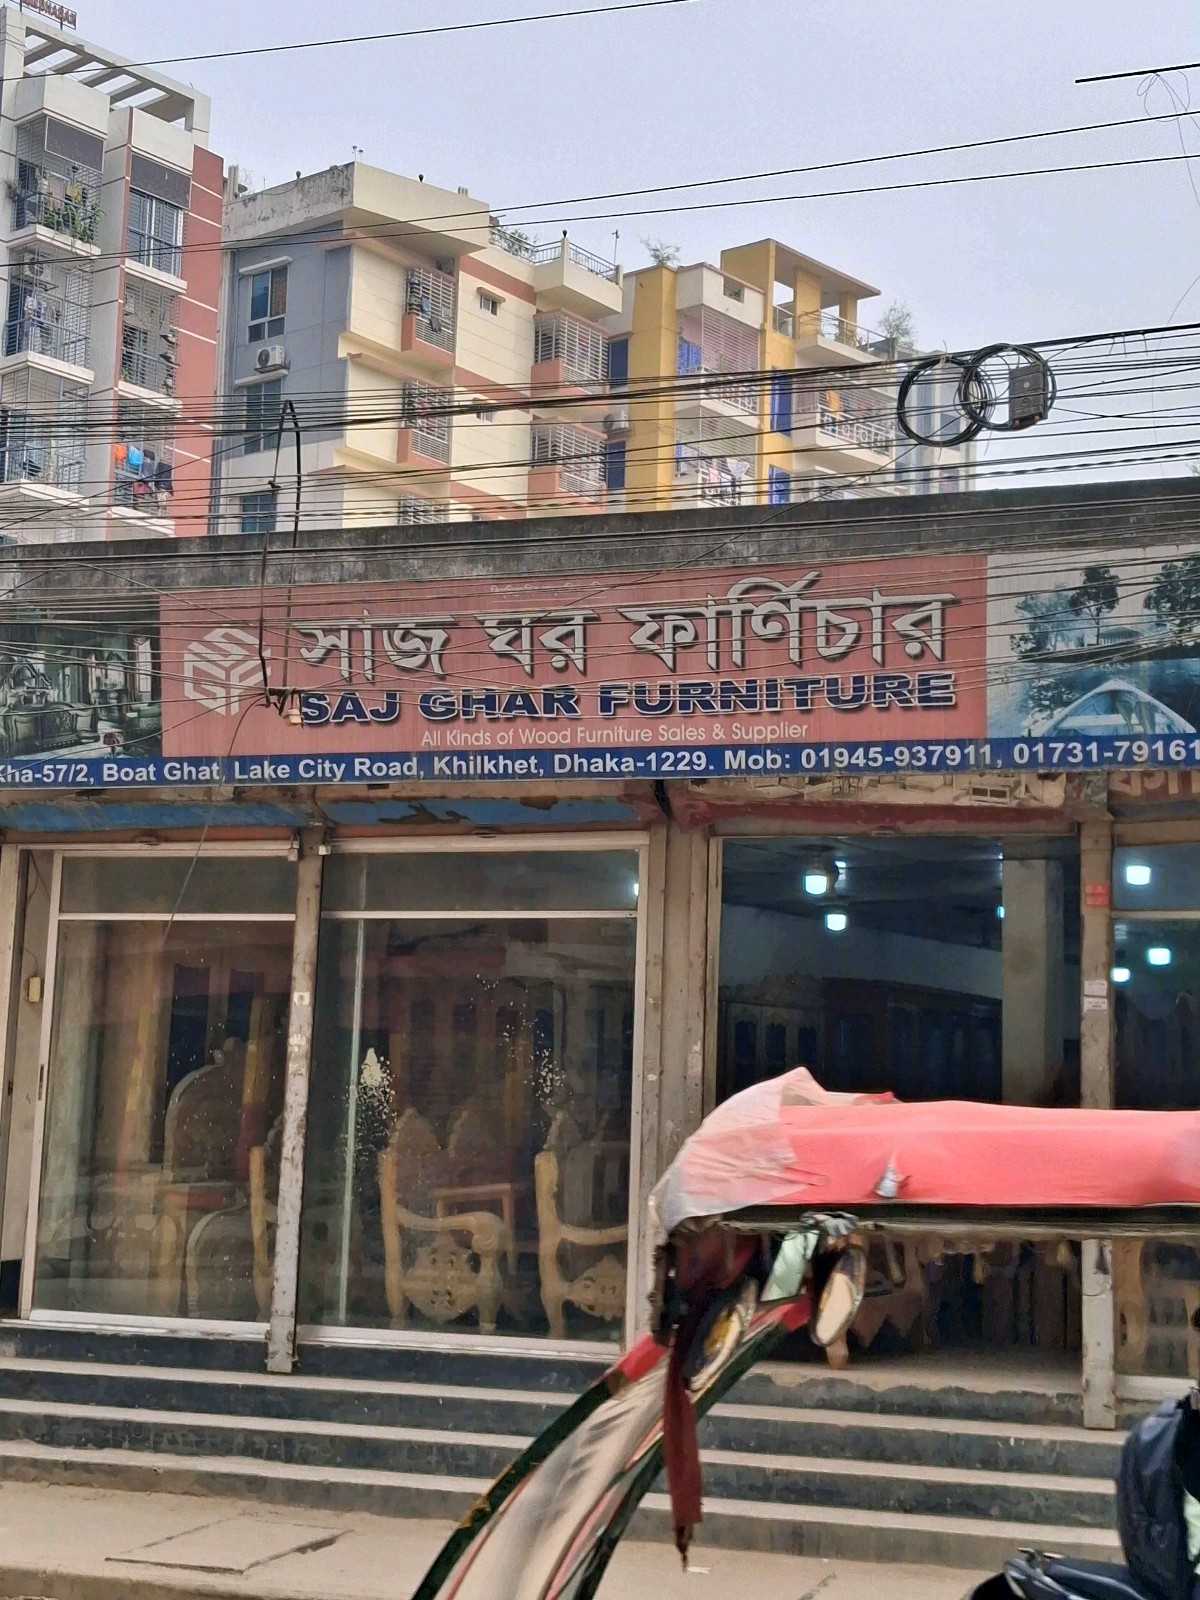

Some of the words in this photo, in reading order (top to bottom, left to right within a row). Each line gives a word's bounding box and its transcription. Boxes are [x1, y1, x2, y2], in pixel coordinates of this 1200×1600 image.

[291, 608, 458, 682] সাজ
[474, 610, 599, 677] ঘর
[301, 690, 400, 725] SAJ
[417, 684, 583, 721] GHAR
[598, 672, 956, 716] FURNITURE
[421, 729, 442, 747] All
[446, 728, 492, 746] Kinds
[497, 728, 514, 745] of
[517, 725, 571, 745] Wood
[577, 725, 653, 743] Furniture
[658, 723, 706, 741] Sales
[712, 723, 725, 740] &
[731, 722, 809, 744] Supplier
[102, 760, 156, 782] Boat
[163, 759, 226, 782] Ghat,
[233, 758, 290, 780] Lake
[298, 758, 345, 782] City
[354, 755, 425, 779] Road,
[433, 754, 544, 777] Khilkhet,
[554, 751, 715, 774] Dhaka-1229.
[724, 749, 792, 770] Mob:
[800, 744, 1003, 769] 01945-937911,
